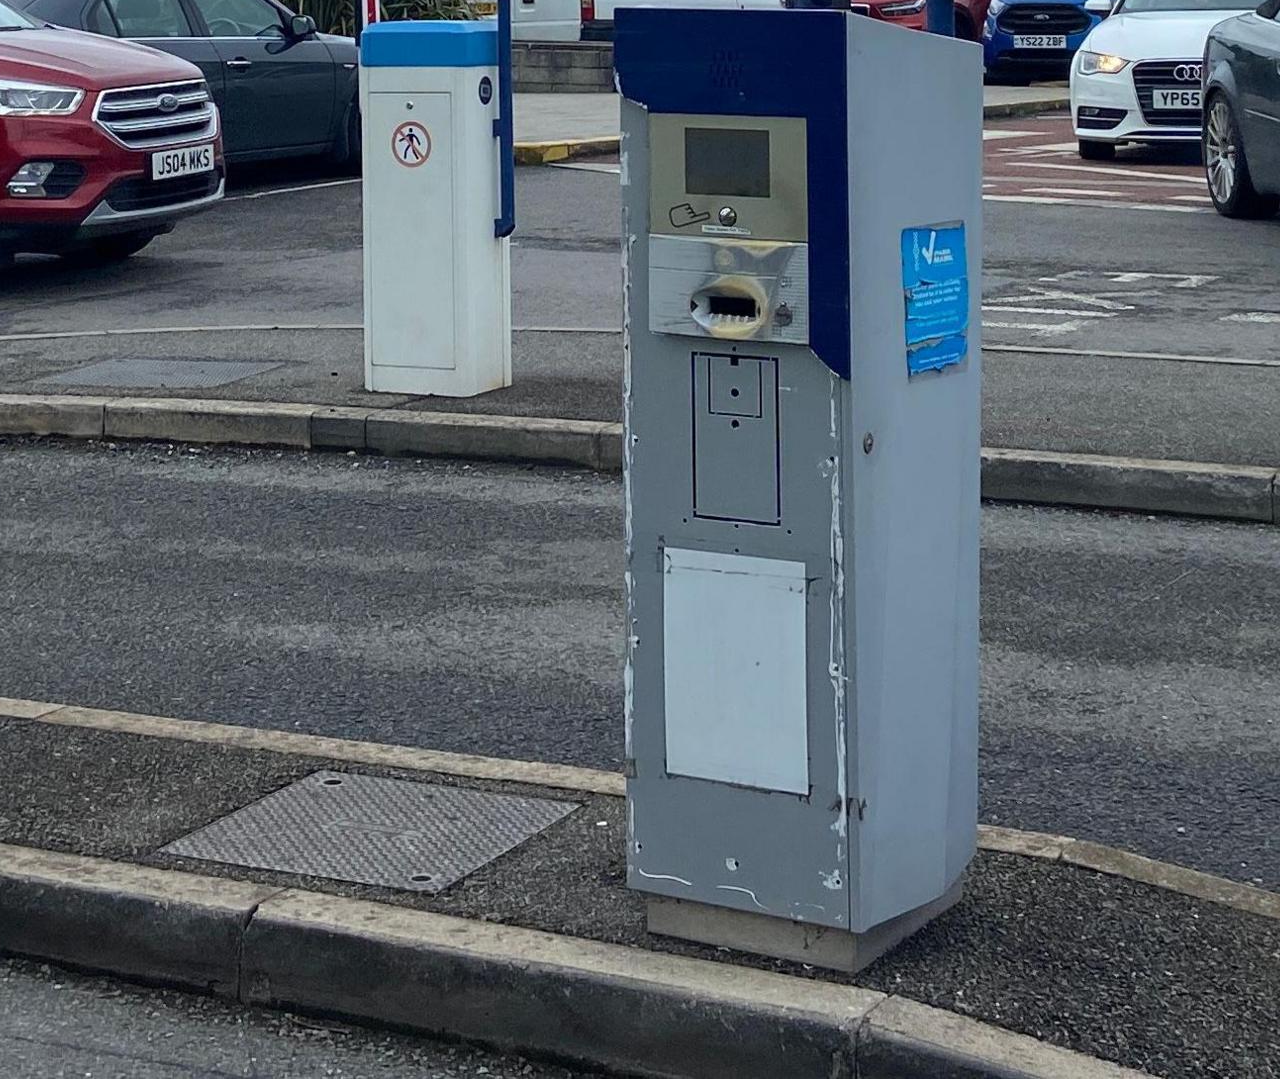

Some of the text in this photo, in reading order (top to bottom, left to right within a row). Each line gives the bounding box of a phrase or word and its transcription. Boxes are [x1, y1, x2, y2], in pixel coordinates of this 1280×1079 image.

[1020, 35, 1044, 46] YS22
[1160, 91, 1200, 106] YP65
[158, 148, 210, 176] JS04 MKS
